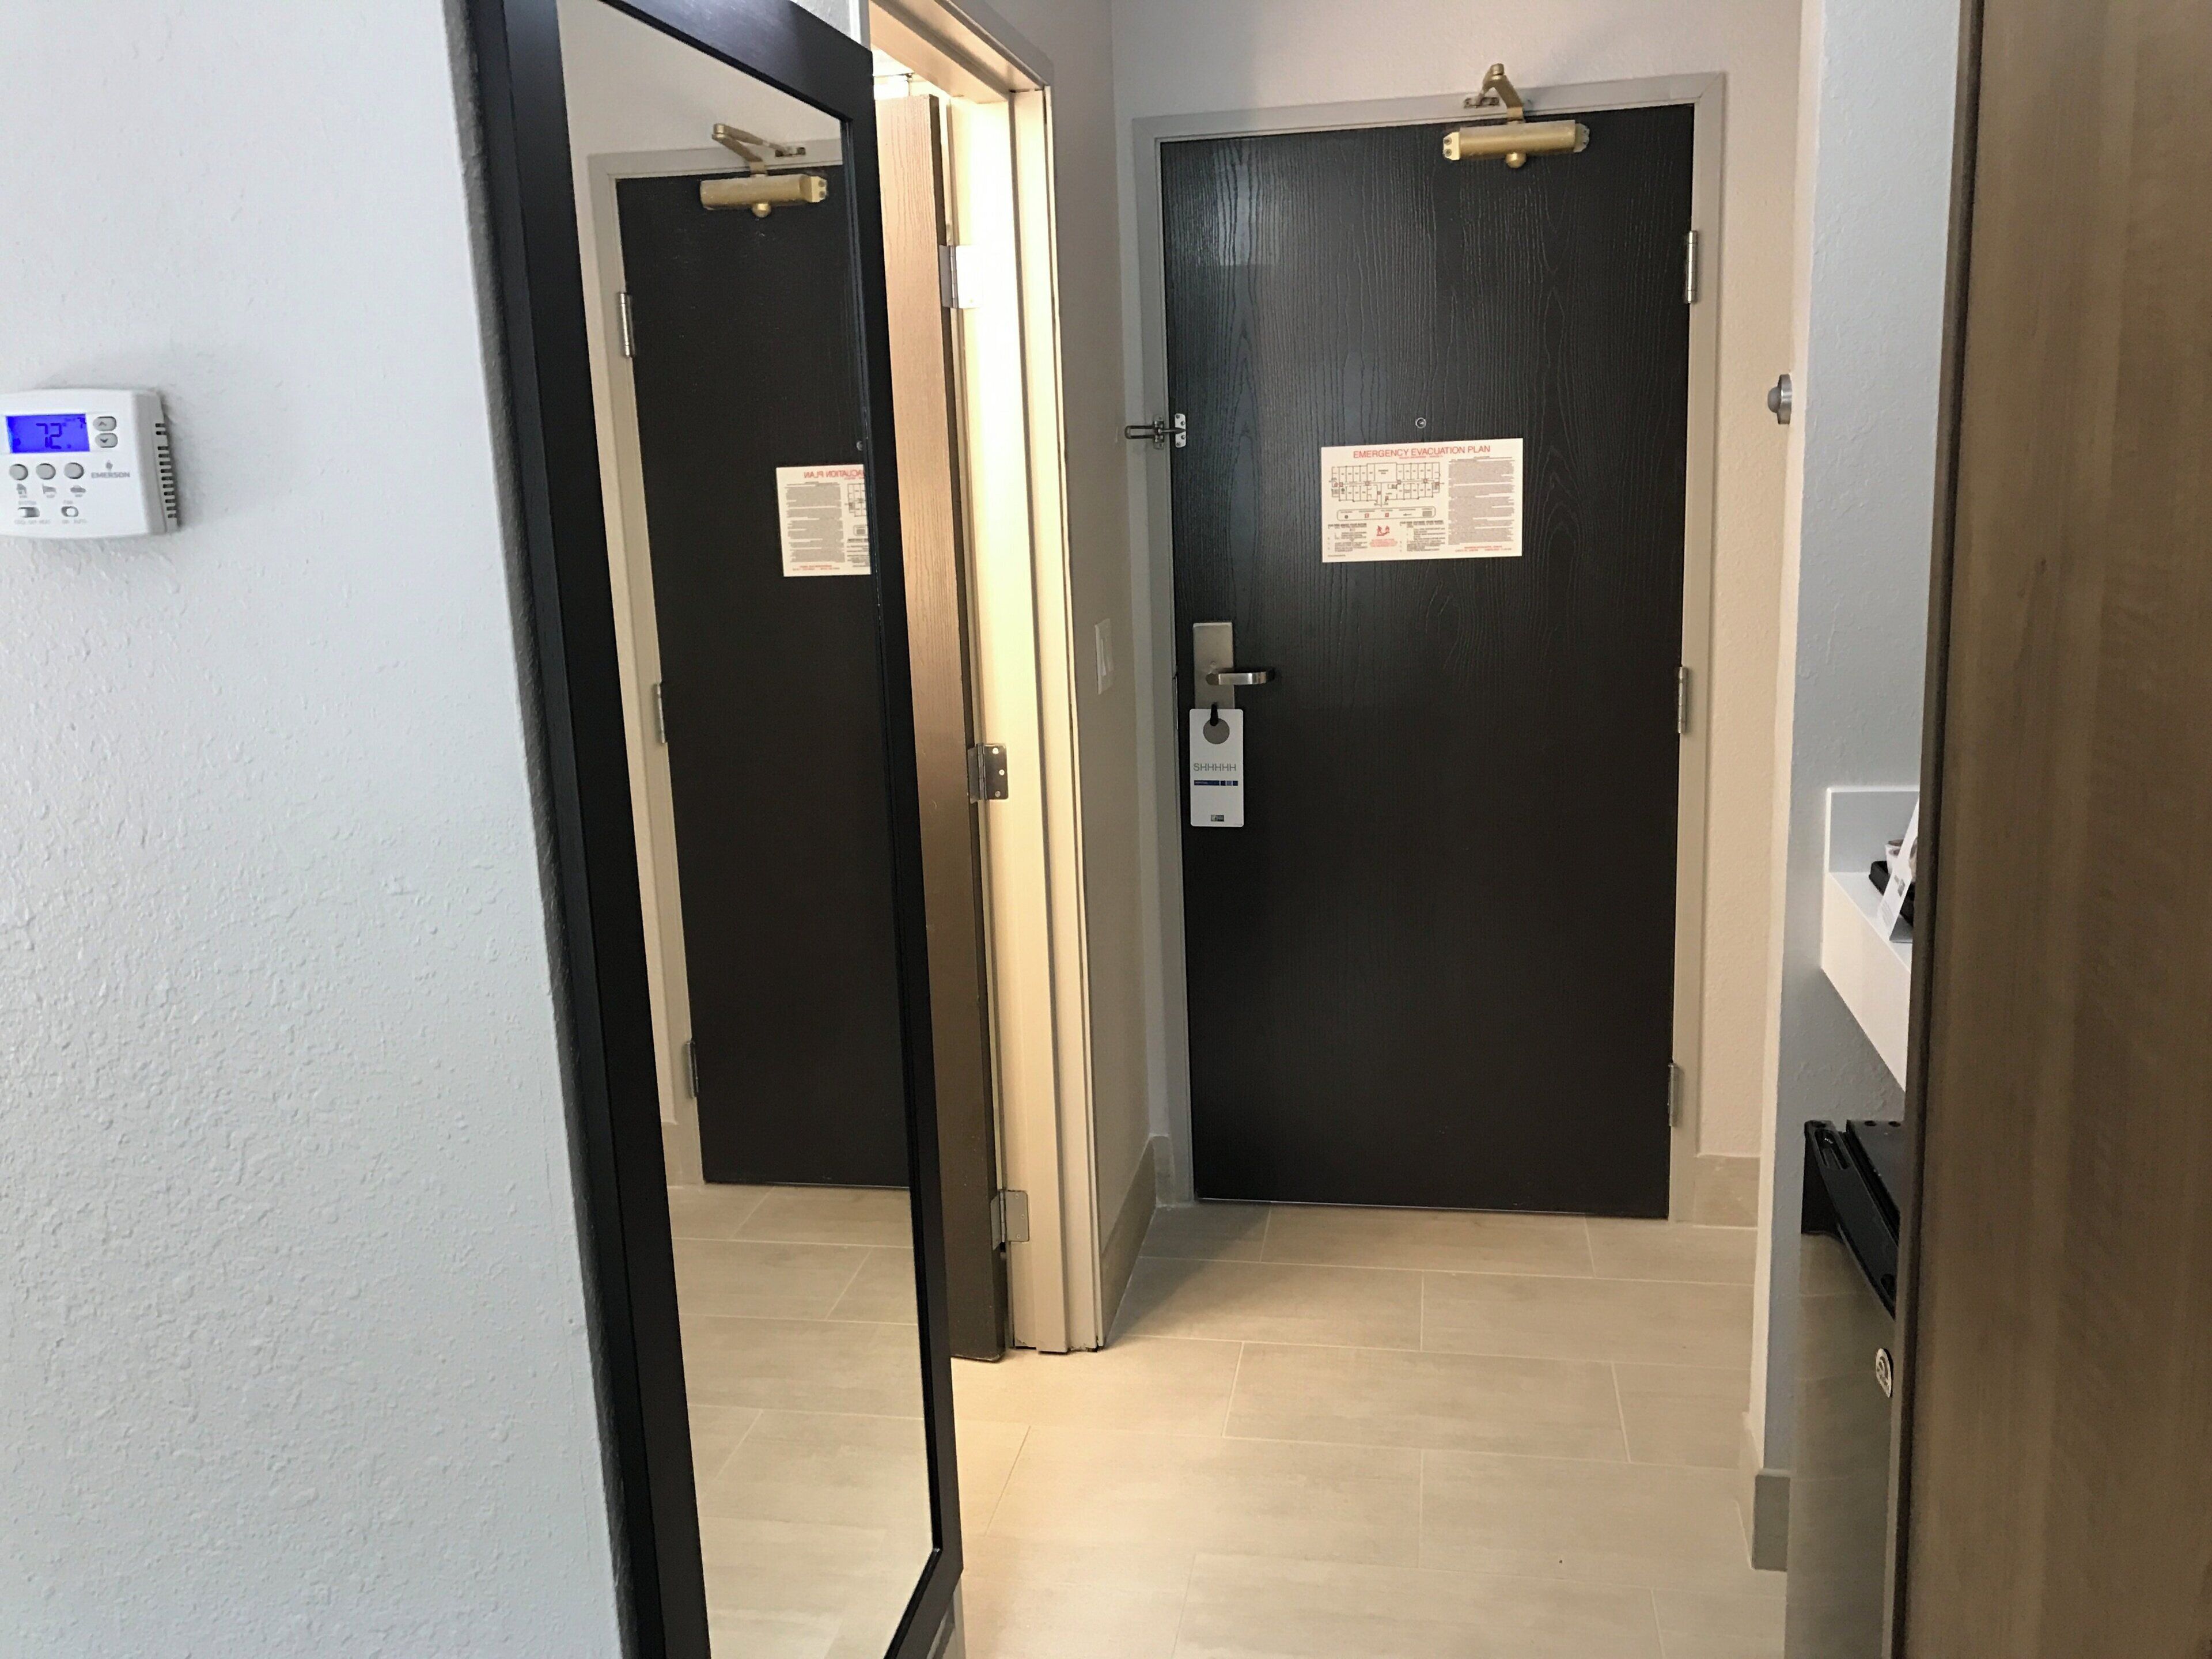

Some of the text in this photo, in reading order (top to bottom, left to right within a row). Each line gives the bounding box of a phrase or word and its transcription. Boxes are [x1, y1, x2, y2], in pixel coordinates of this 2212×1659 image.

[36, 422, 62, 449] 72
[1353, 449, 1409, 459] EMERGENCY
[1411, 446, 1465, 456] EVACUATION
[1468, 445, 1491, 453] PLAN
[1193, 763, 1237, 772] SHHHHH
